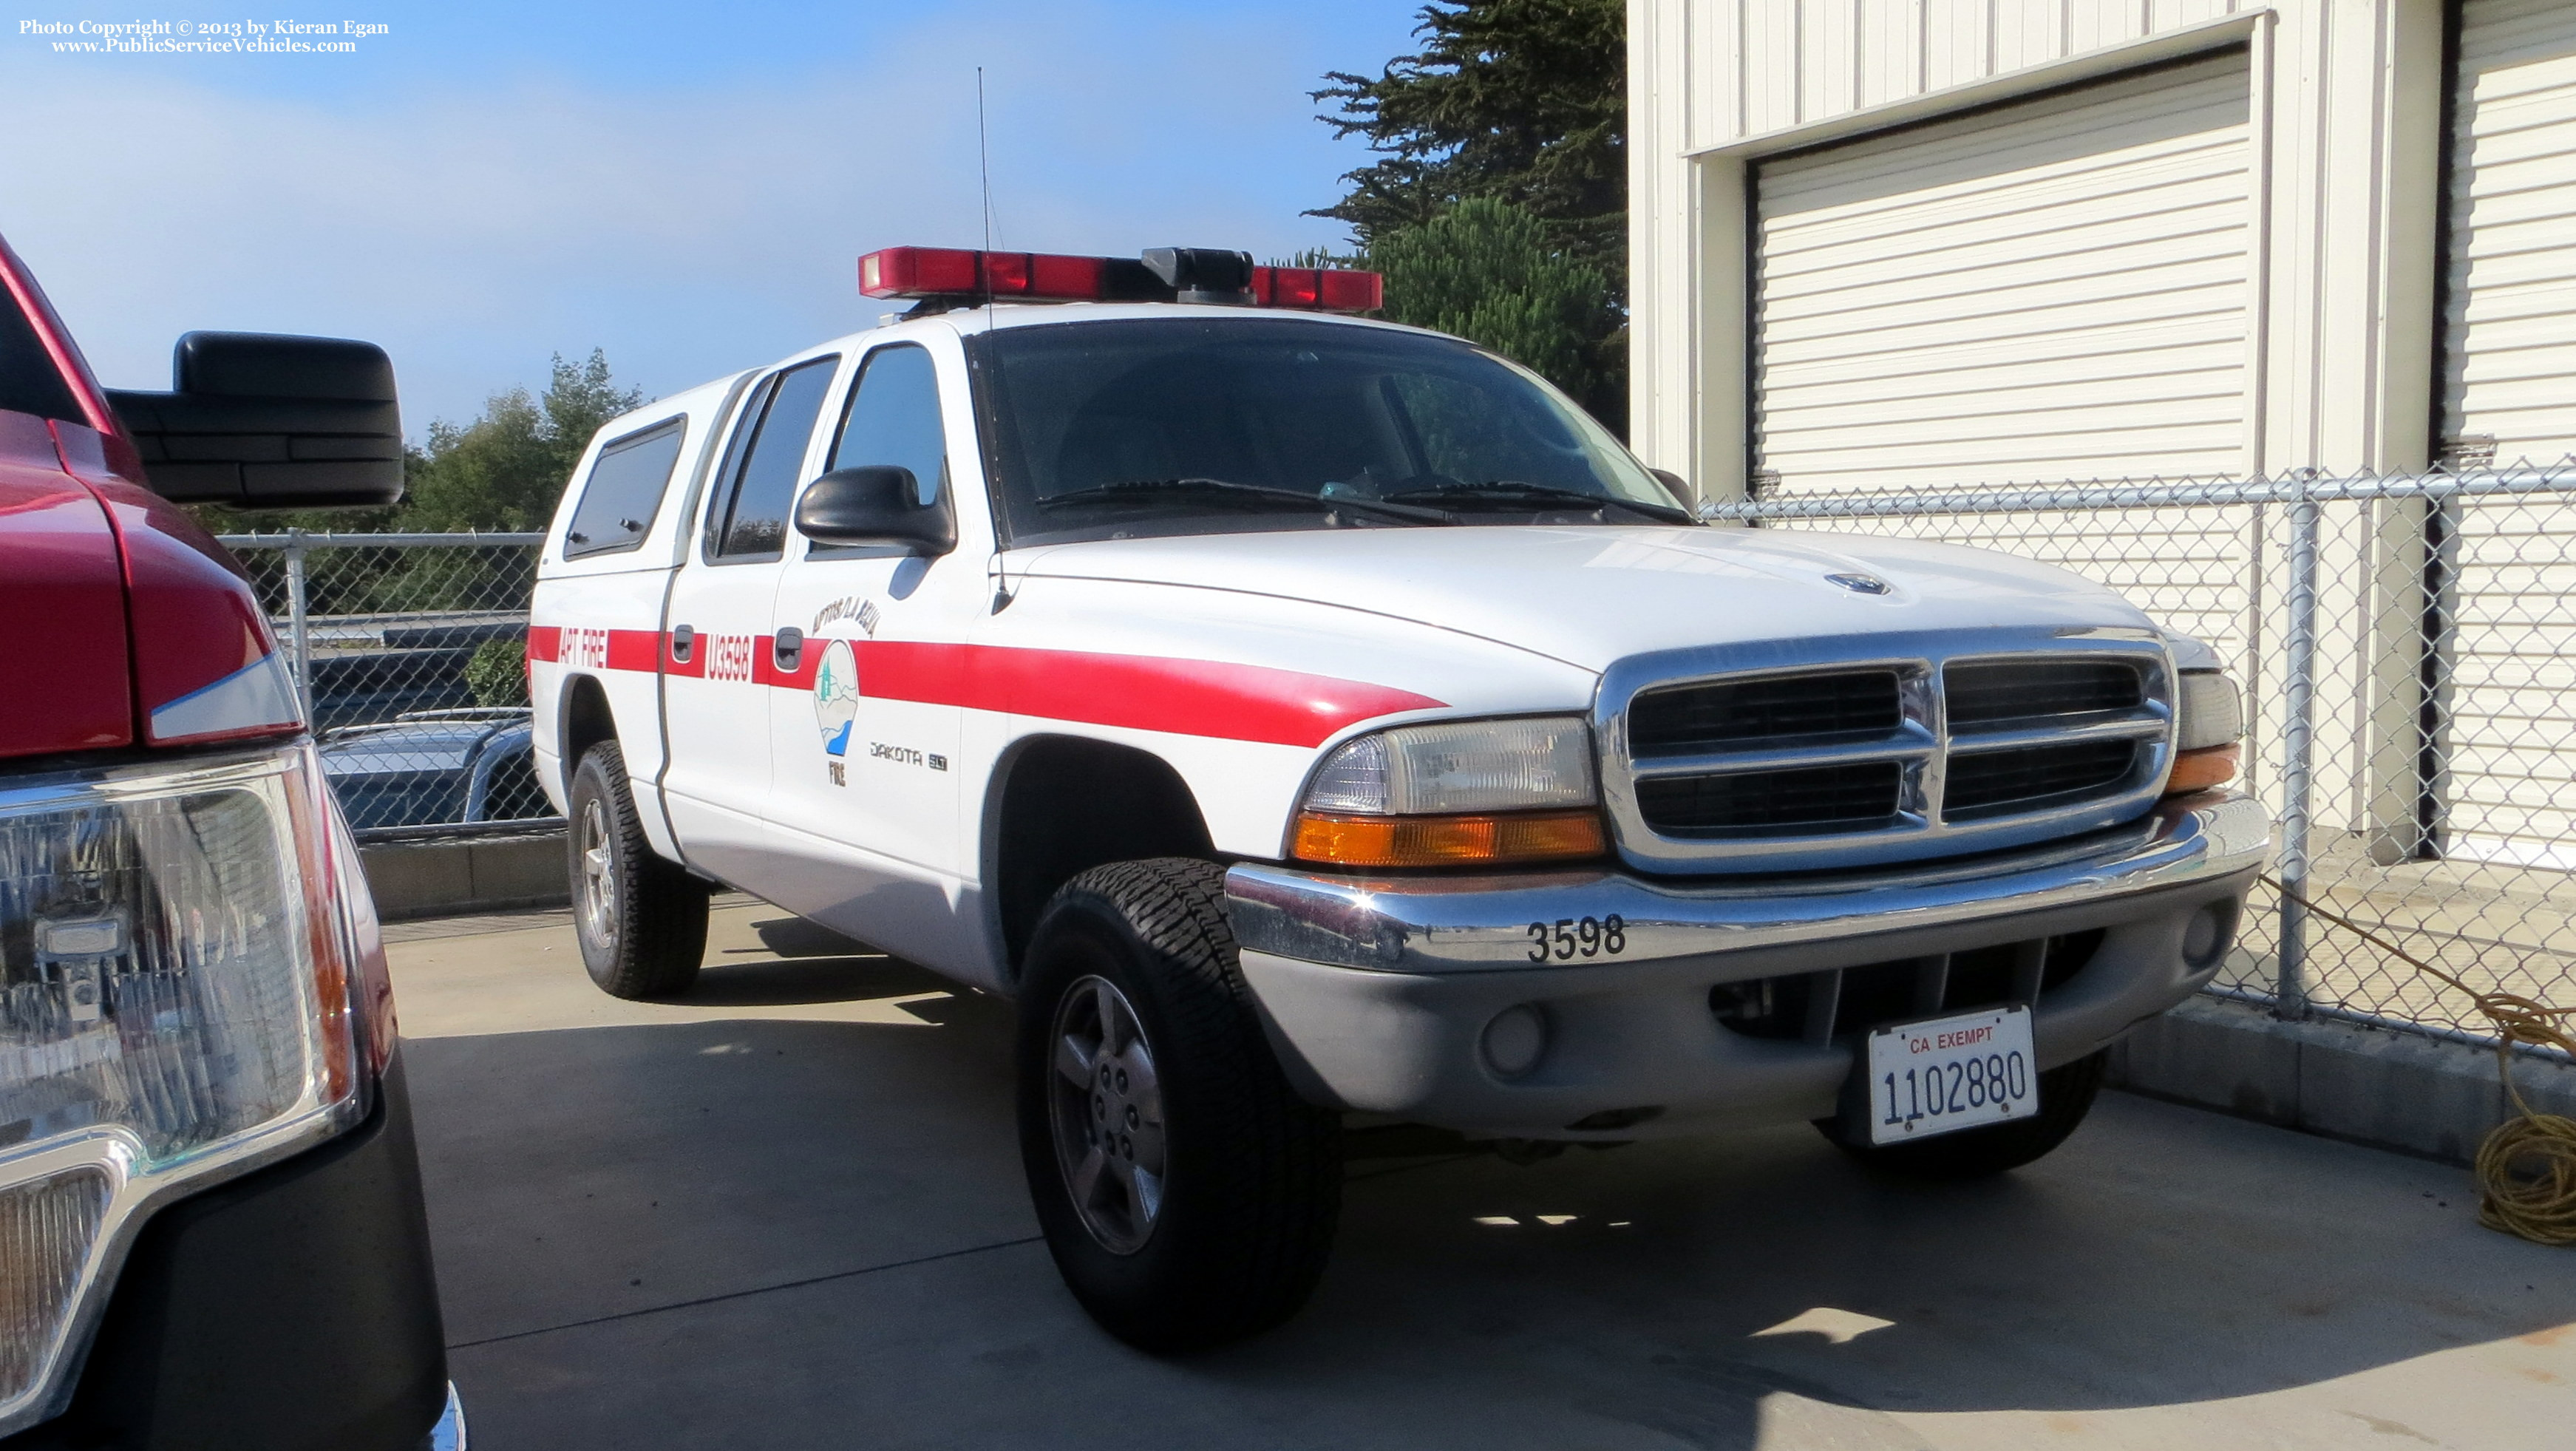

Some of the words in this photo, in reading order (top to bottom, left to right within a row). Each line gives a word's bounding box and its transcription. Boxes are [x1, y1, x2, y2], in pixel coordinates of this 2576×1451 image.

[560, 628, 579, 665] APT
[582, 628, 605, 668] FIRE
[708, 633, 750, 682] U3598
[829, 761, 846, 787] FIRE
[871, 741, 922, 767] DAKOTA
[929, 753, 948, 772] SLT
[1527, 914, 1625, 962] 3598
[1910, 1039, 1930, 1054] CA
[1938, 1026, 1993, 1050] EXEMPT
[1885, 1050, 2026, 1125] 1102880
